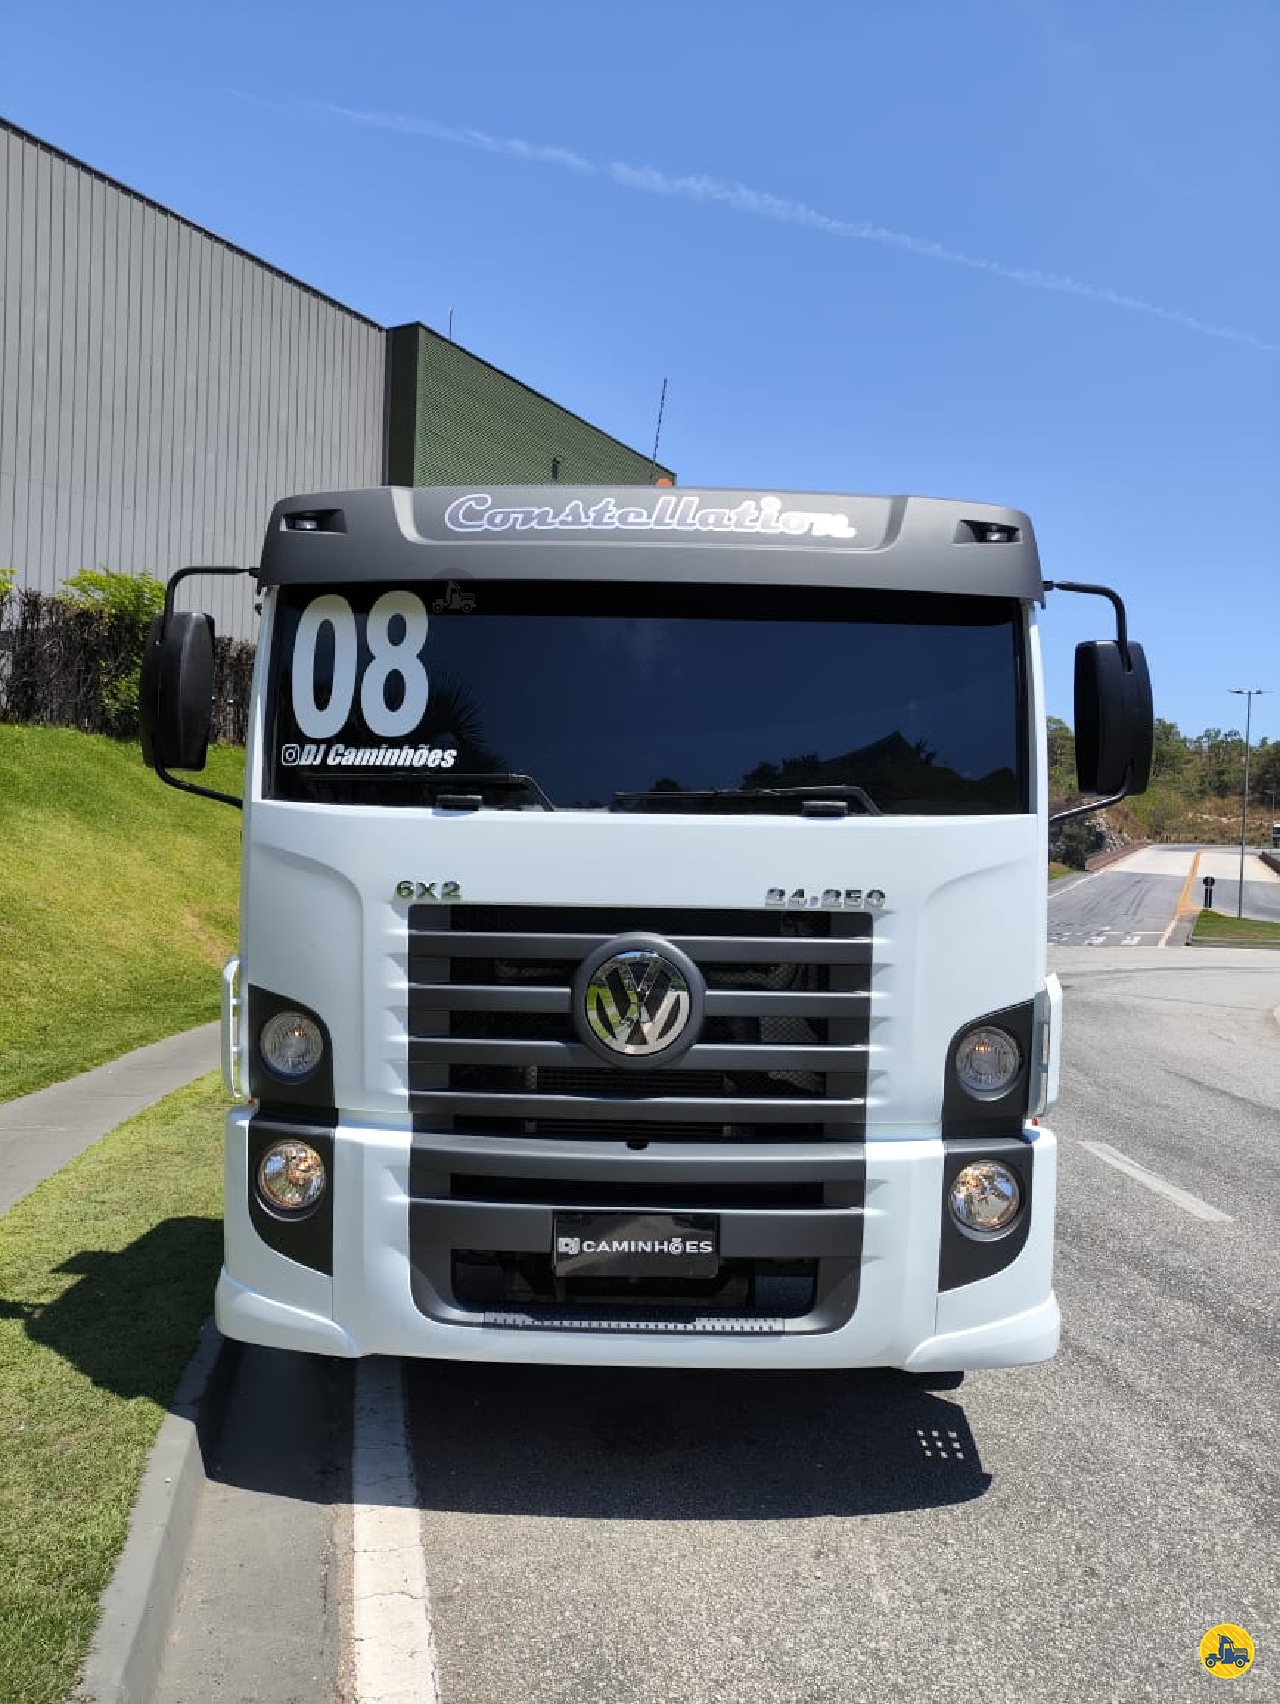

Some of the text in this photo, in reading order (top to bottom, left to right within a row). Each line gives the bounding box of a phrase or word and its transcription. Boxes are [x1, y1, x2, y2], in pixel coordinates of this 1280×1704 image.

[444, 493, 857, 539] Constellation
[291, 589, 429, 739] 08
[299, 743, 458, 768] DJ Caminhões
[765, 888, 886, 908] 24.250
[582, 1237, 713, 1255] CAMINHÕES
